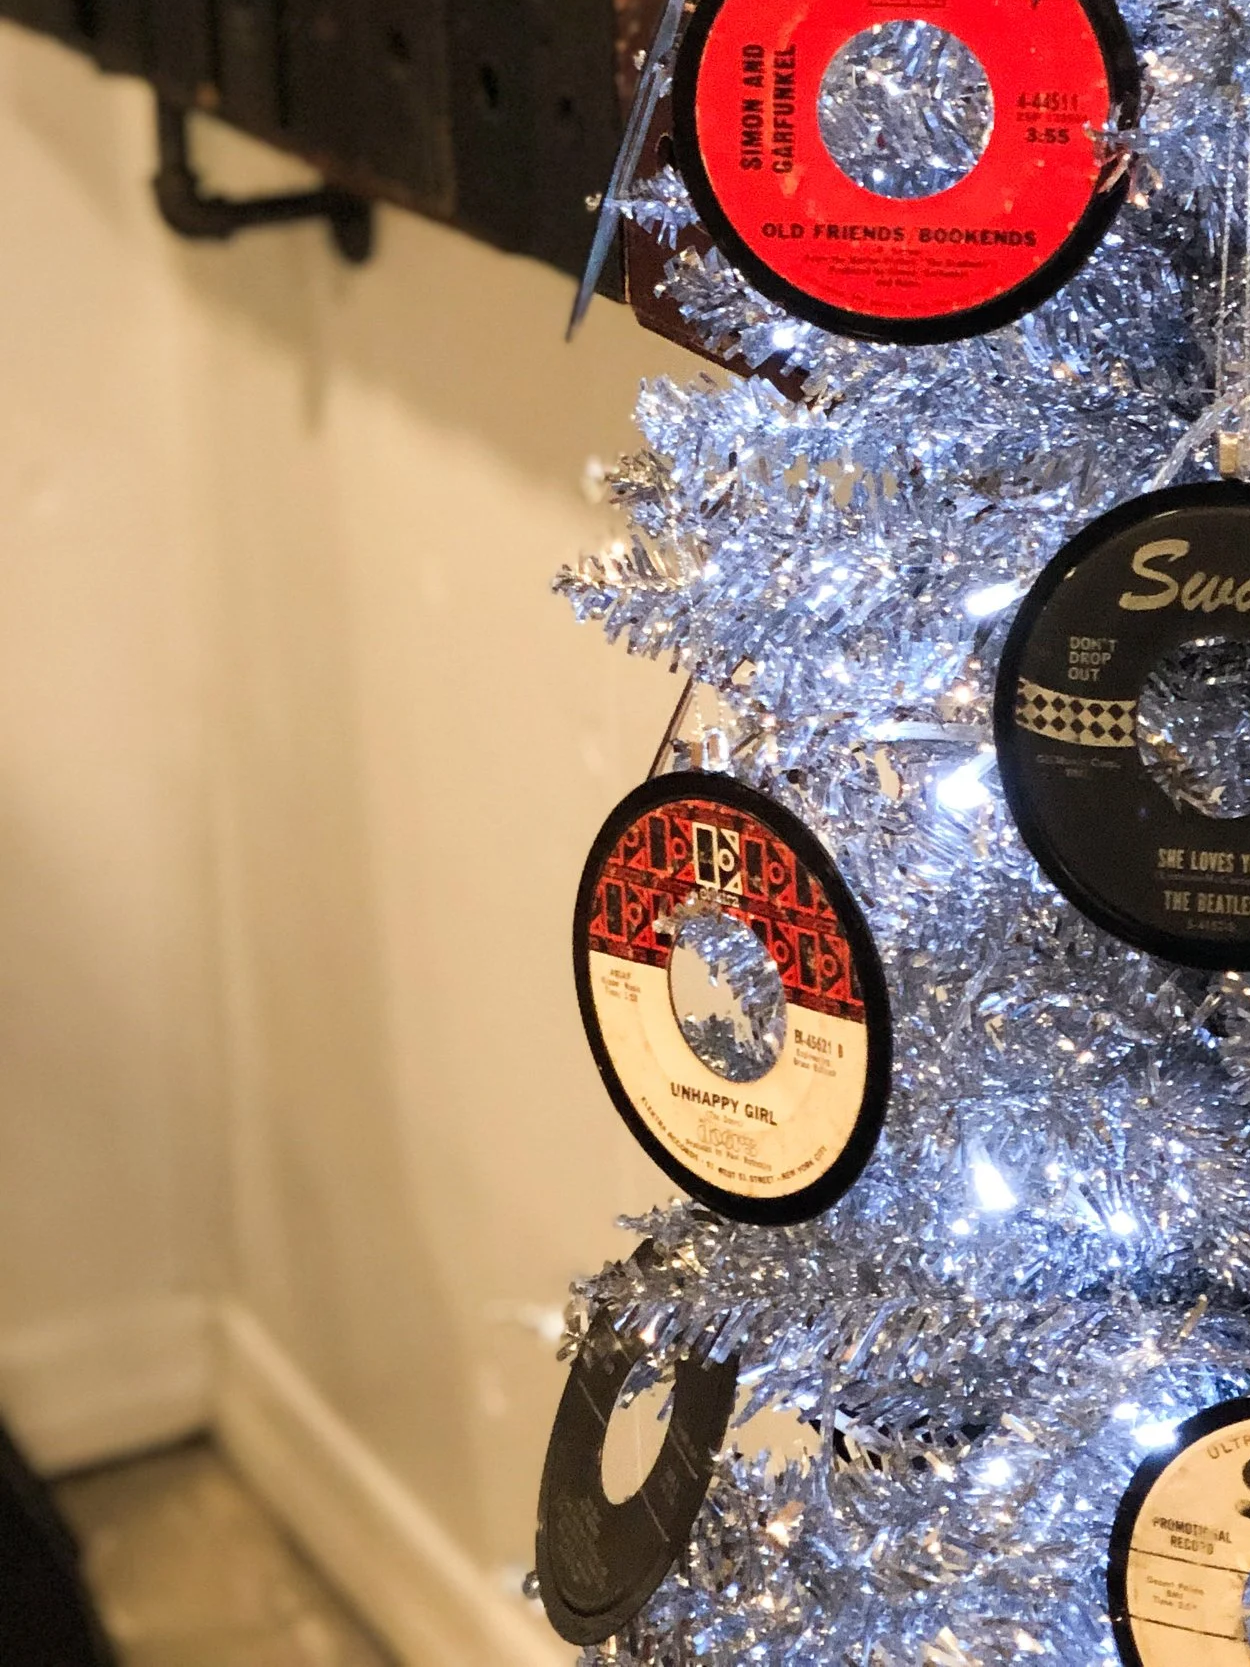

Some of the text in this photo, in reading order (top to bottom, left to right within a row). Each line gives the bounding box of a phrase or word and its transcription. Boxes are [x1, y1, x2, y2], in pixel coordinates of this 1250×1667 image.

[740, 44, 765, 171] SIMON AND
[772, 44, 796, 174] GARFUNKEL
[761, 222, 804, 239] OLD
[919, 227, 1037, 247] BOOKENDS
[1069, 651, 1112, 665] DROP
[1068, 667, 1100, 681] OUT
[1158, 848, 1185, 870] SHE
[1190, 851, 1235, 873] LOVES
[1163, 890, 1191, 912] THE
[670, 1082, 778, 1126] UNHAPPY GIRL
